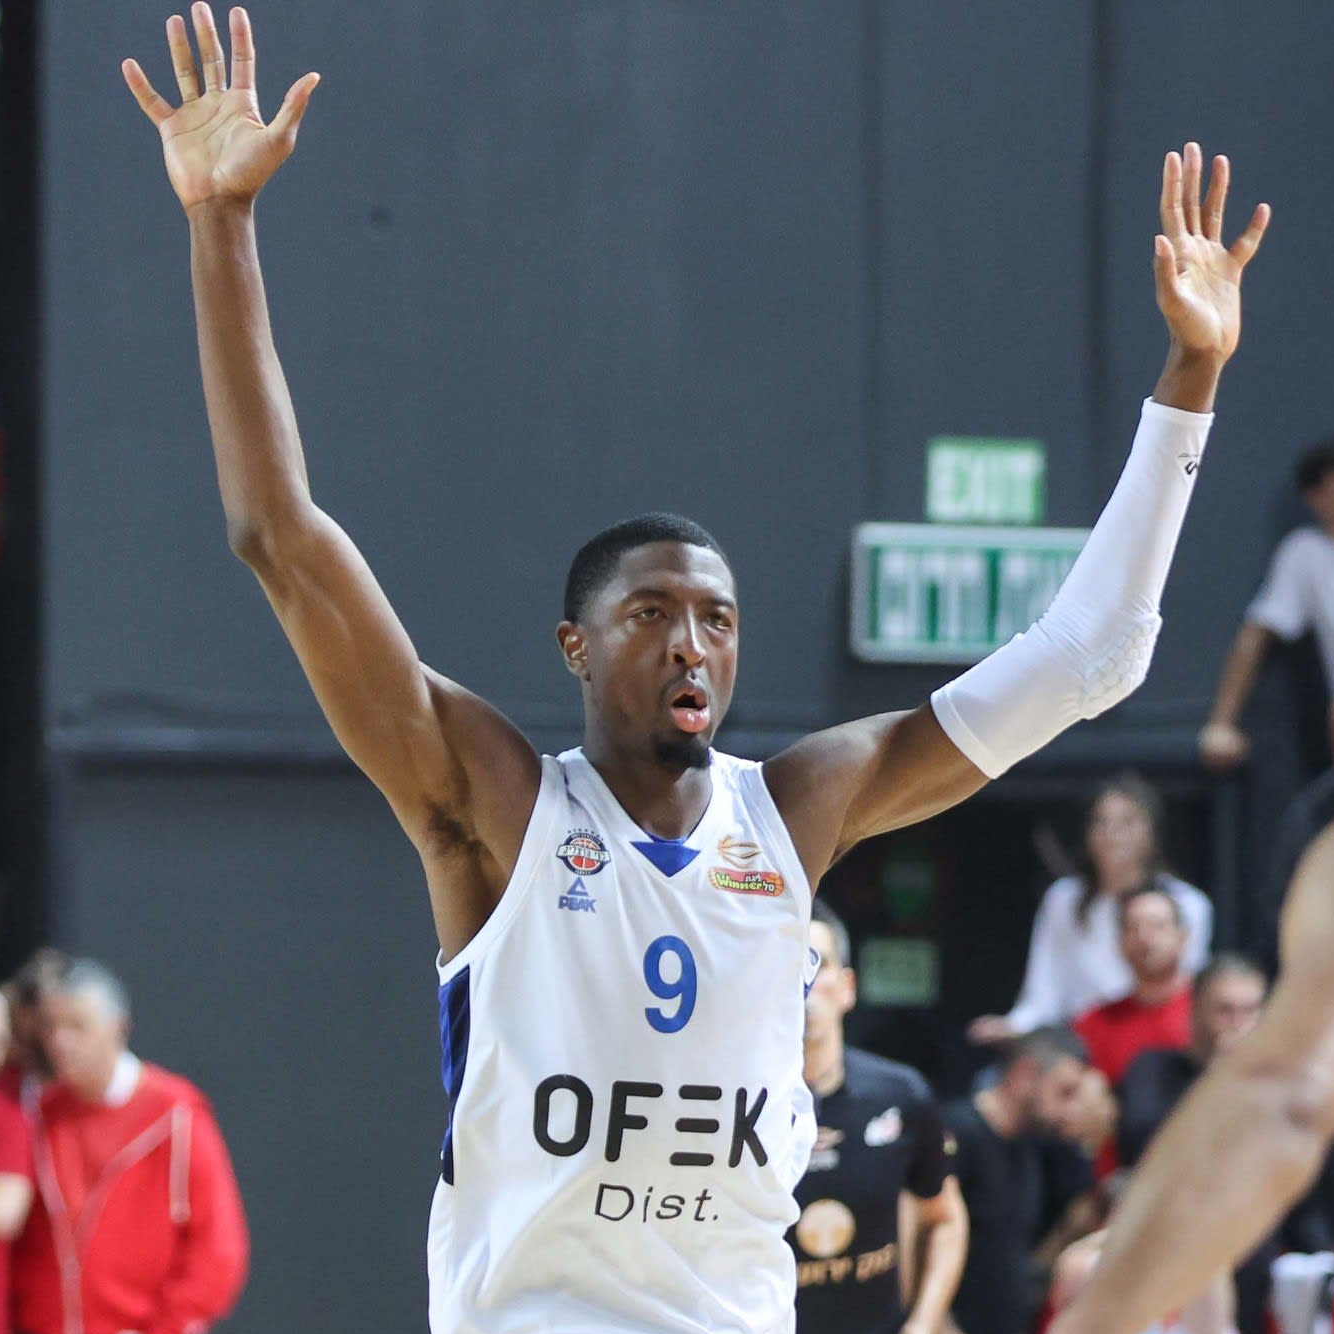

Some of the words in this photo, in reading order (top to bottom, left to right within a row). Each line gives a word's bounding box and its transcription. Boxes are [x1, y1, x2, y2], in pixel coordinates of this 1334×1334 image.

[715, 872, 763, 891] Winner
[558, 895, 597, 914] PEAK
[642, 935, 698, 1034] 9
[533, 1073, 769, 1169] OFEK
[594, 1183, 719, 1223] Dist.
